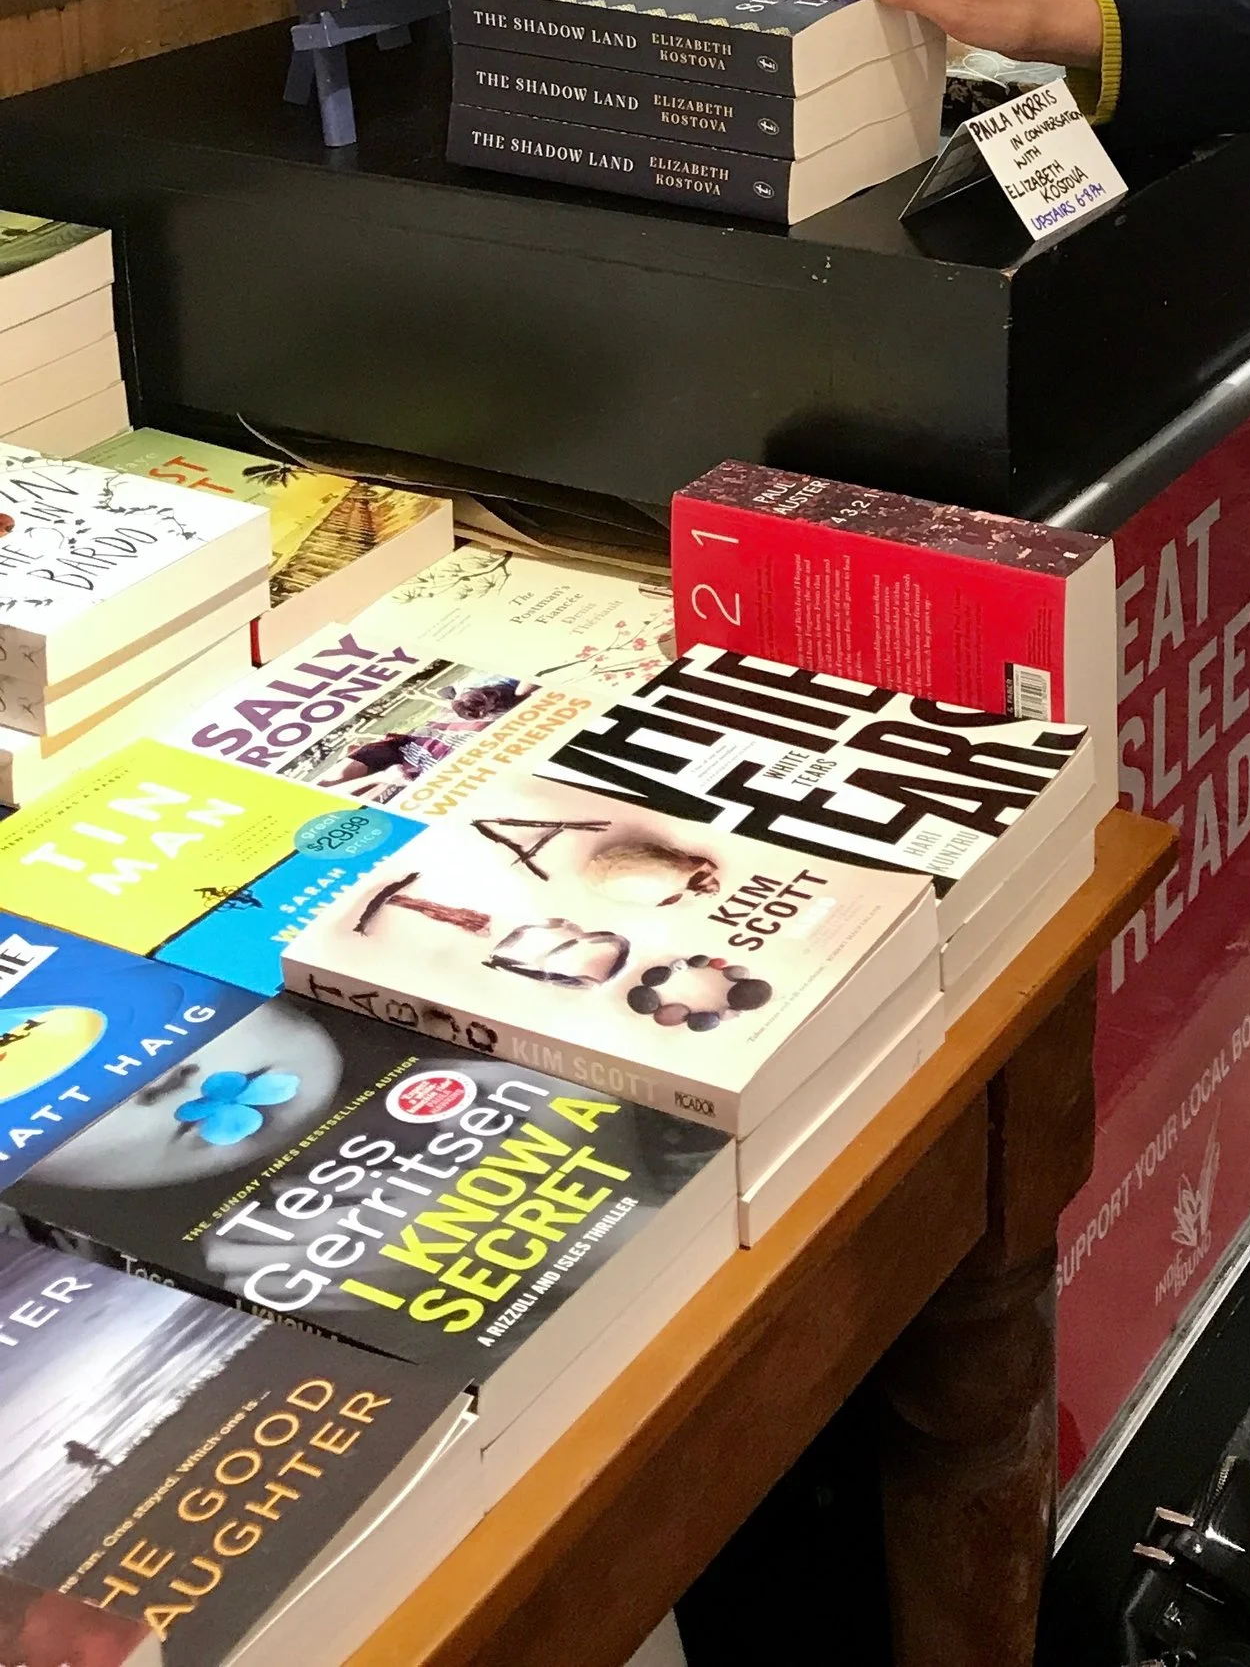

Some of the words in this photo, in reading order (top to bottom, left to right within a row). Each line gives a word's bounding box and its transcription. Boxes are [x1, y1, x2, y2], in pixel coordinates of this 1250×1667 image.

[473, 10, 507, 30] THE
[513, 16, 586, 41] SHADOW
[591, 28, 638, 50] LAND
[651, 33, 733, 57] ELIZABETH
[659, 49, 727, 72] KOSTOVA
[475, 70, 510, 91] THE
[515, 76, 588, 103] SHADOW
[593, 90, 640, 112] LAND
[653, 93, 734, 119] ELIZABETH
[660, 111, 728, 134] KOSTOVA
[969, 112, 1012, 143] PAULA
[1011, 89, 1058, 125] MORRIS
[1010, 134, 1024, 151] IN
[1024, 111, 1084, 143] CONVERSATION
[471, 130, 505, 152] THE
[510, 137, 583, 164] SHADOW
[588, 151, 634, 173] LAND
[649, 156, 730, 182] ELIZABETH
[1014, 146, 1042, 170] WITH
[655, 173, 722, 197] KOSTOVA
[1005, 159, 1064, 200] ELIZABETH
[1040, 166, 1089, 204] KOSTOVA
[1031, 202, 1076, 231] UPSTAIRS
[752, 482, 796, 504] PAUL
[773, 480, 831, 515] AUSTER
[27, 526, 159, 591] BARDO
[508, 590, 535, 607] The
[509, 584, 572, 625] Postman's
[1114, 497, 1222, 703] EAT
[192, 632, 380, 757] SALLY
[235, 644, 421, 769] ROONEY
[400, 690, 568, 813] CONVERSATIONS
[423, 767, 498, 820] WITH
[496, 696, 593, 767] FRIENDS
[762, 749, 811, 781] WHITE
[791, 757, 838, 788] TEARS
[20, 780, 193, 873] TIN
[87, 797, 246, 896] MAN
[301, 813, 341, 840] great
[307, 816, 370, 852] $29.99
[345, 828, 382, 854] price
[903, 830, 942, 857] HARI
[926, 831, 980, 874] KUNZRU
[279, 868, 347, 913] SARAH
[706, 873, 782, 929] KIM
[728, 868, 829, 952] SCOTT
[104, 1002, 218, 1077] HAIG
[673, 1090, 716, 1117] PICADOR
[1134, 1113, 1180, 1191] YOUR
[1179, 1056, 1231, 1133] LOCAL
[183, 1218, 211, 1244] THE
[212, 1178, 260, 1221] SUNDAY
[260, 1147, 302, 1186] TIMES
[300, 1087, 377, 1156] BESTSELLING
[375, 1055, 421, 1094] AUTHOR
[215, 1133, 397, 1244] Tess
[243, 1076, 550, 1313] Gerritsen
[339, 1277, 407, 1312] I
[378, 1123, 565, 1276] KNOW
[547, 1096, 623, 1134] A
[408, 1146, 632, 1334] SECRET
[476, 1333, 493, 1349] A
[487, 1292, 539, 1341] RIZZOLI
[530, 1270, 562, 1306] AND
[553, 1240, 592, 1280] ISLES
[586, 1196, 639, 1246] THRILLER
[83, 1537, 176, 1609] HE
[177, 1377, 336, 1525] GOOD
[143, 1391, 391, 1643] AUGHTER
